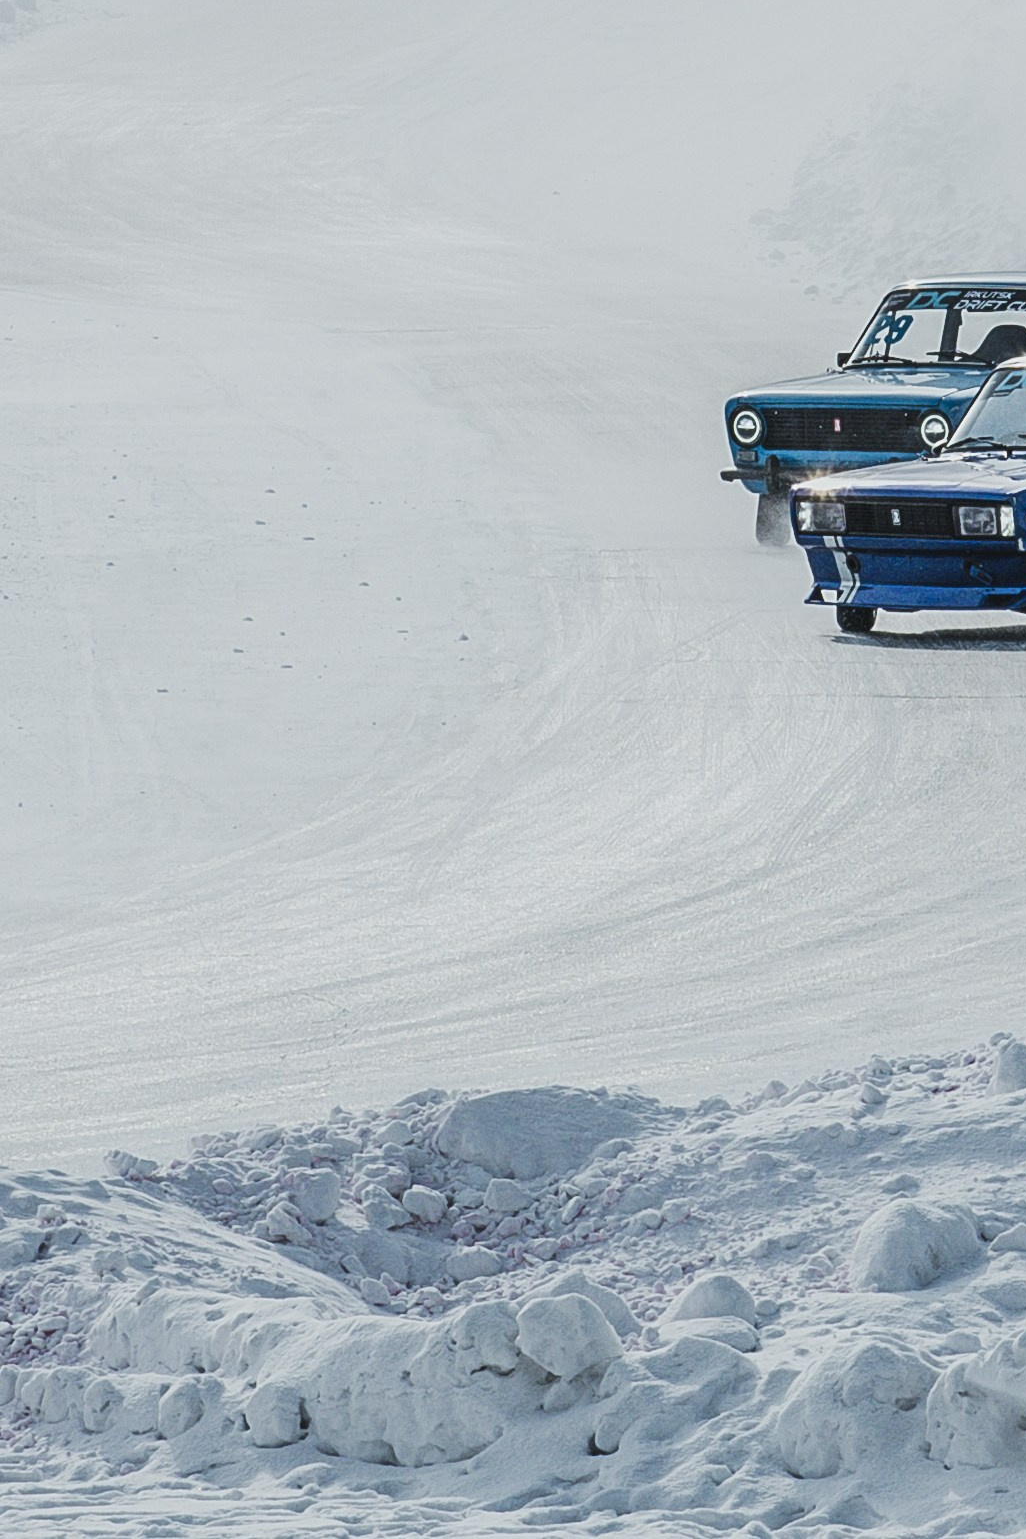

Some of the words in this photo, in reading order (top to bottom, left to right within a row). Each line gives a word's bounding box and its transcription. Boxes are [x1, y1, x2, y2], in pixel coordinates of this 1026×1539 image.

[905, 291, 962, 310] DC
[963, 291, 1017, 300] IRKUTSK
[952, 299, 1006, 311] DRIFT
[864, 313, 915, 345] 29
